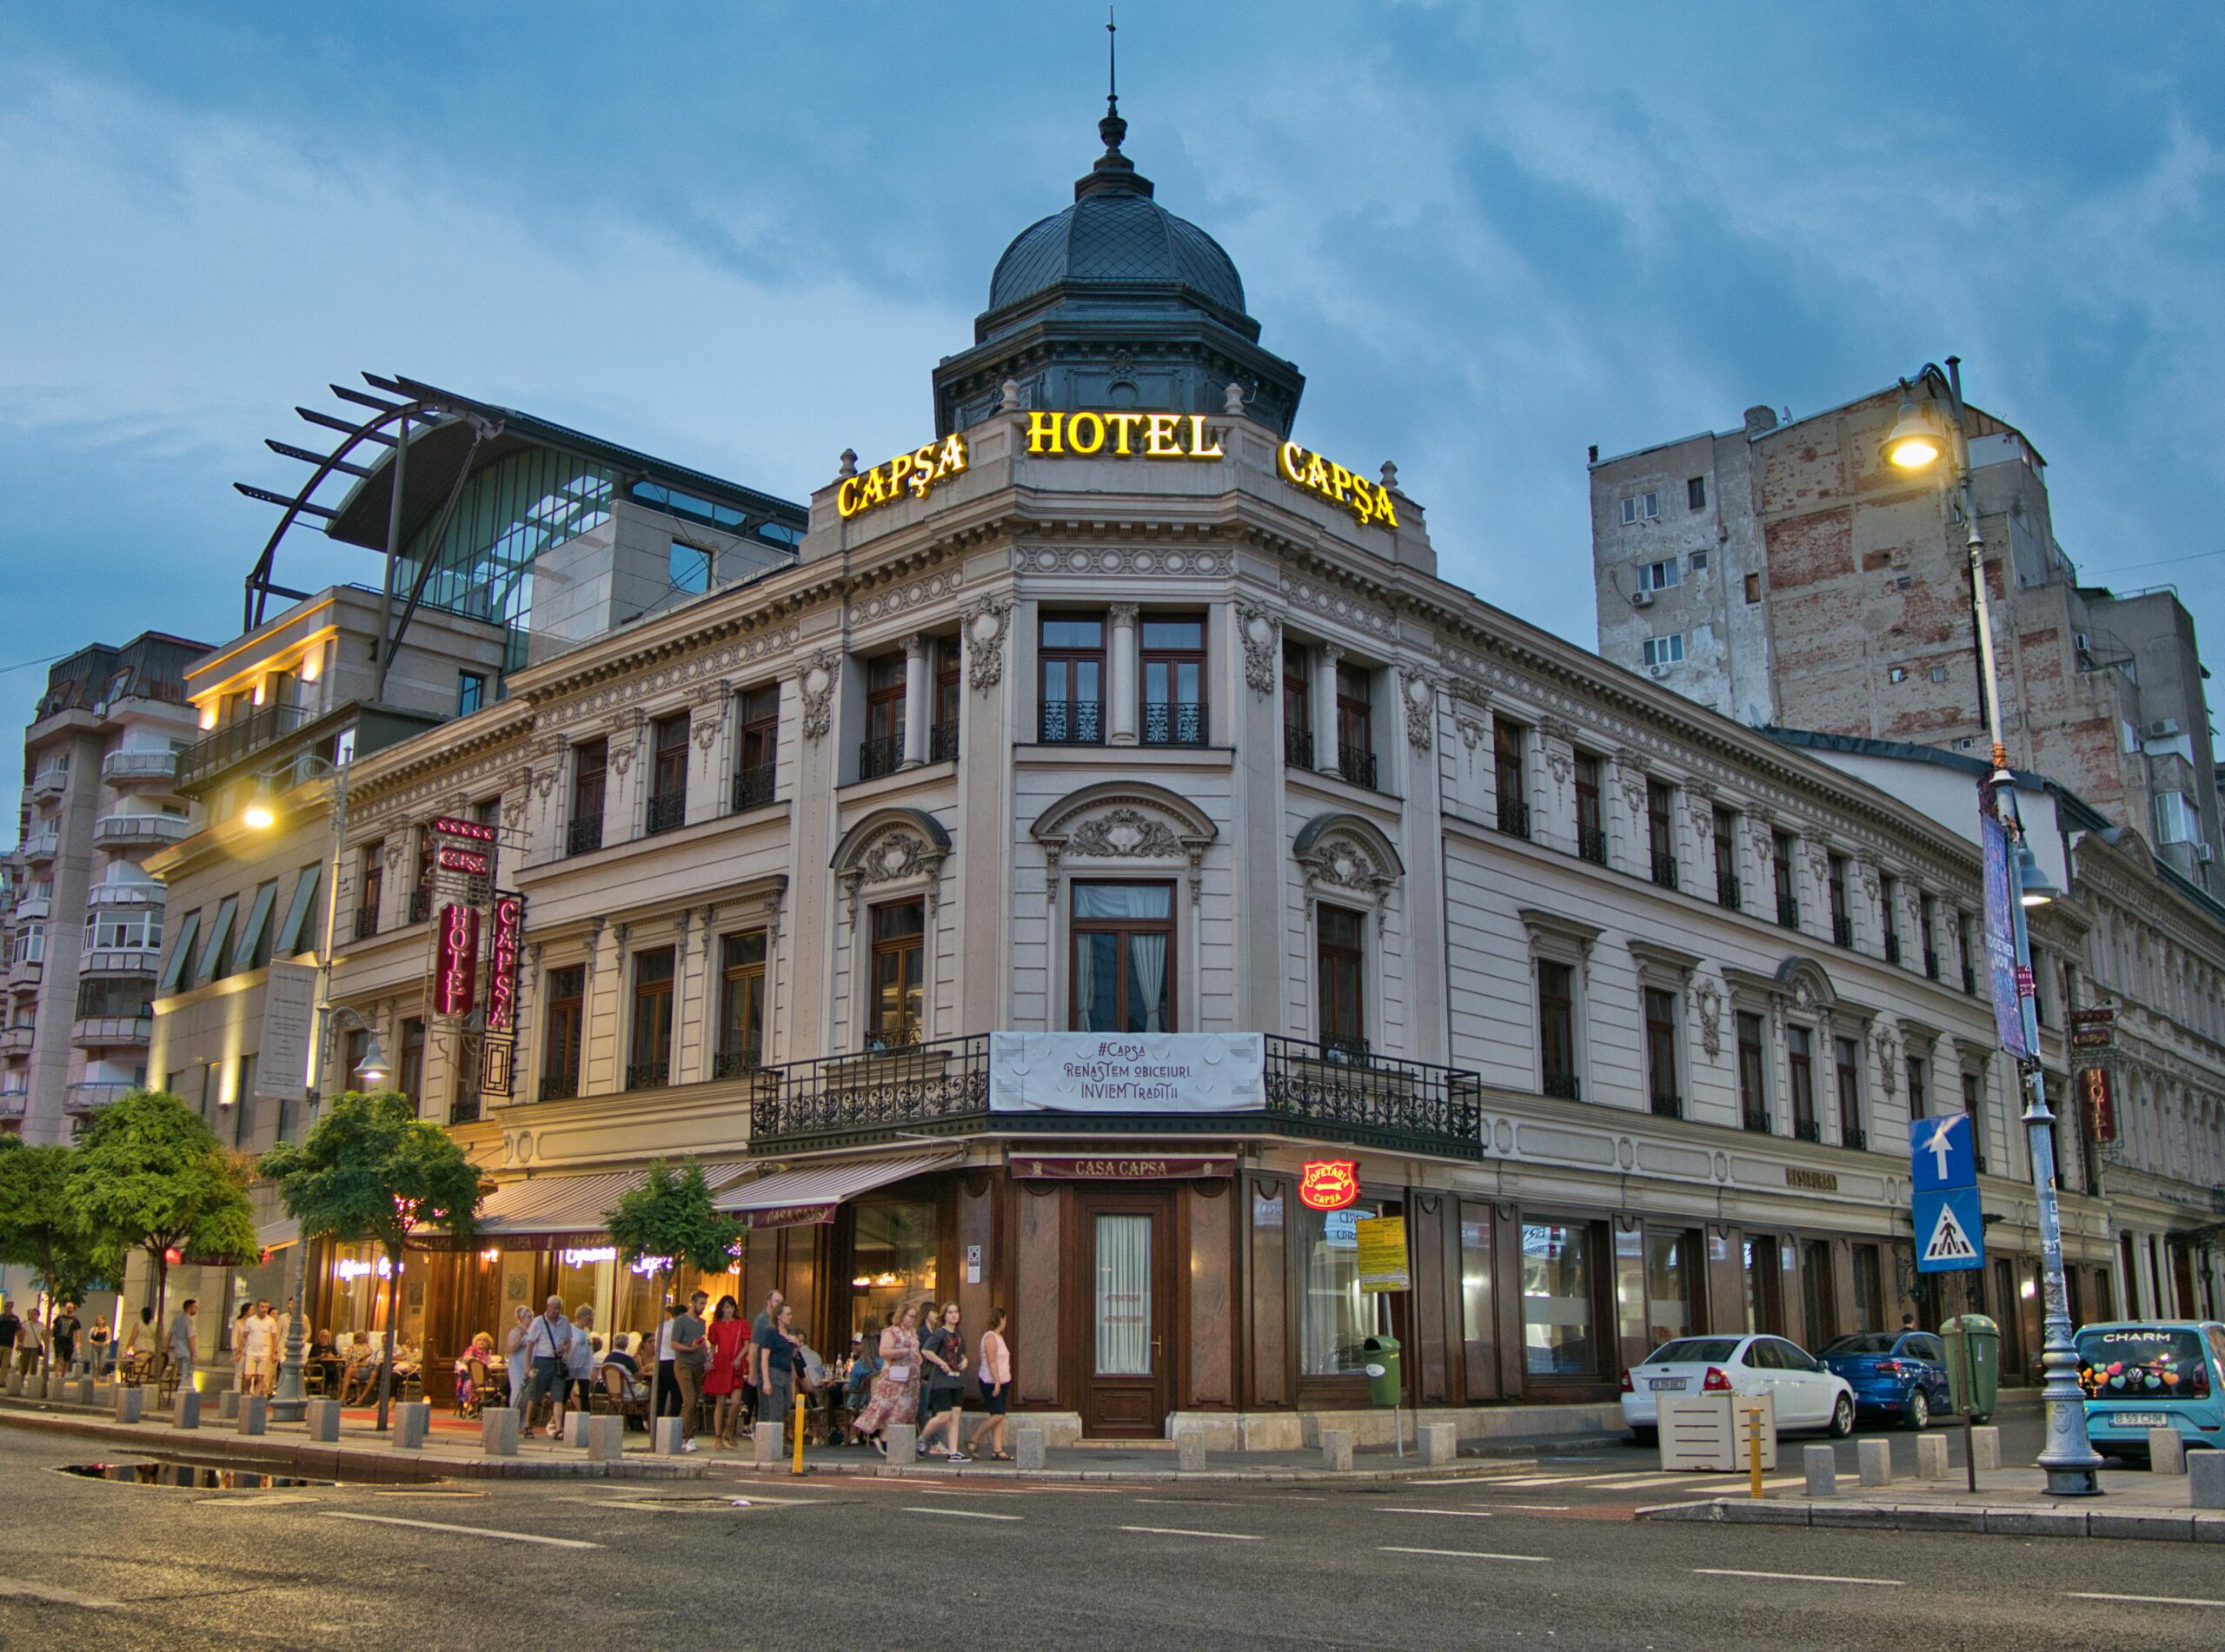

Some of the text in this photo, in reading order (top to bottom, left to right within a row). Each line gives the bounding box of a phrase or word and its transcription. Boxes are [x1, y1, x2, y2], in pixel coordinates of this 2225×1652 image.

[1026, 411, 1224, 458] HOTEL
[447, 906, 469, 1015] HOTEL
[2090, 1069, 2105, 1142] HOTEL
[1075, 1161, 1168, 1176] CASA CAPSA
[2103, 1333, 2170, 1342] CHARM
[2115, 1413, 2122, 1423] B
